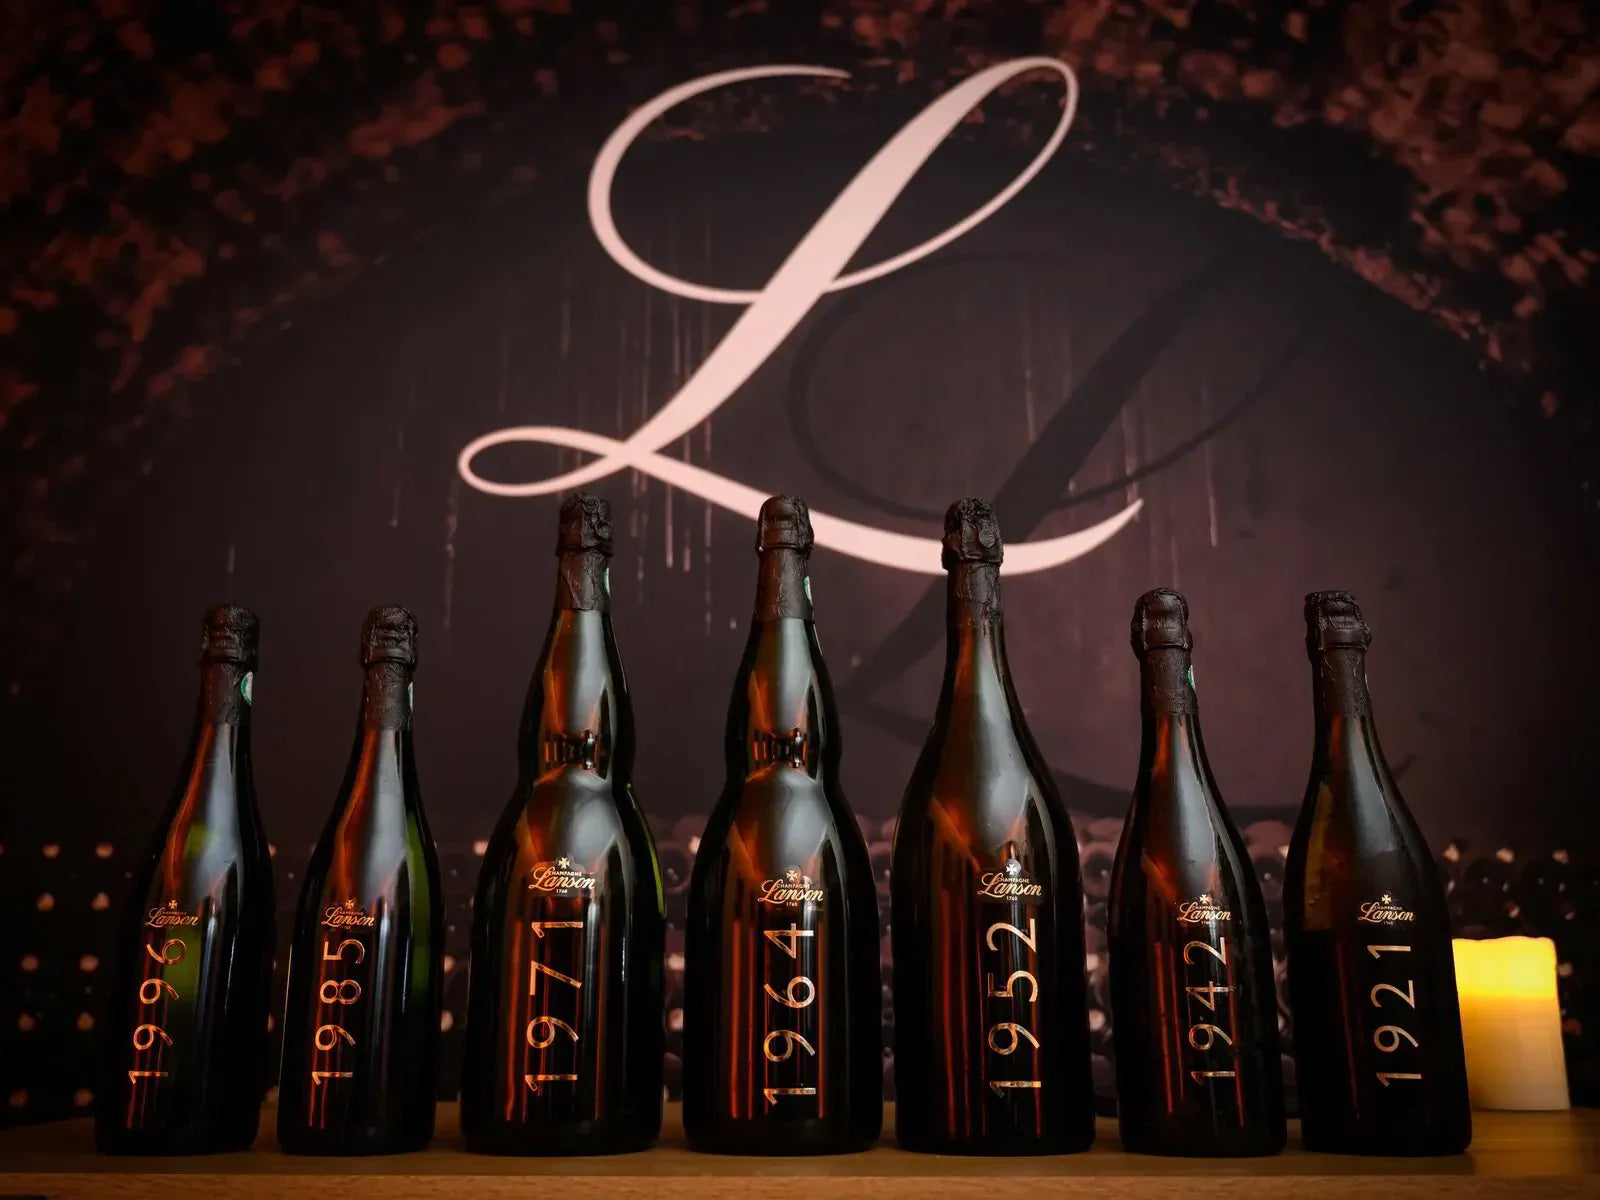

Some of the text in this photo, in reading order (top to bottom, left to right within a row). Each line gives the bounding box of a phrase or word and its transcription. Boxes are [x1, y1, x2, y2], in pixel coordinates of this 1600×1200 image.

[458, 56, 1143, 576] L
[144, 907, 200, 928] Lanson
[321, 906, 375, 928] Lanson
[528, 866, 596, 892] Lanson
[757, 878, 824, 904] Lanson
[977, 872, 1042, 898] Lanson
[1176, 901, 1231, 923] Lanson
[1358, 901, 1415, 923] Lanson
[128, 938, 187, 1085] 1996
[311, 938, 366, 1086] 1985
[524, 921, 584, 1092] 1971
[763, 922, 816, 1105] 1964
[986, 917, 1042, 1099] 1952
[1183, 936, 1236, 1086] 1942
[1366, 945, 1422, 1088] 1921
